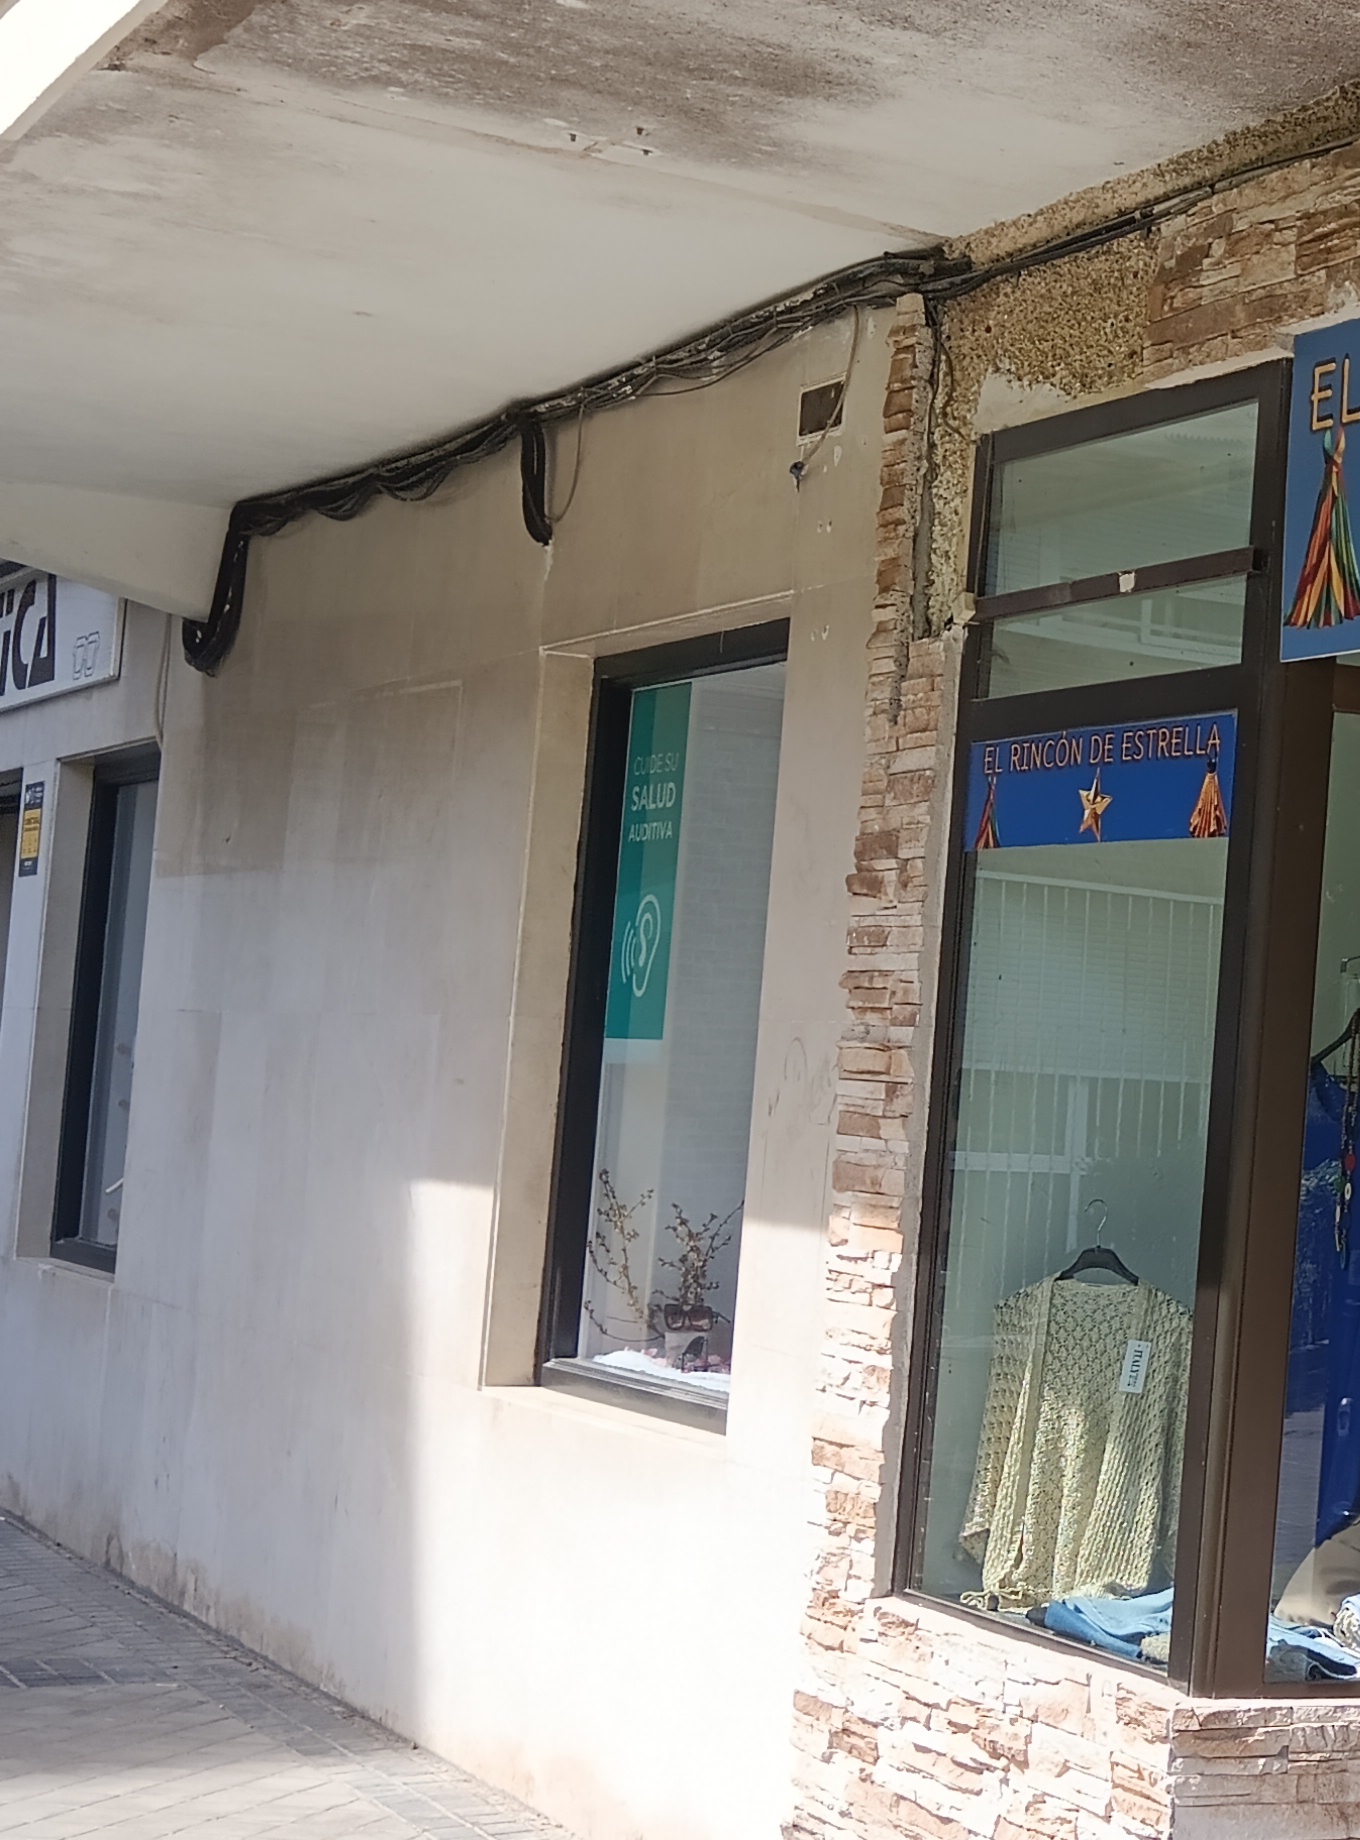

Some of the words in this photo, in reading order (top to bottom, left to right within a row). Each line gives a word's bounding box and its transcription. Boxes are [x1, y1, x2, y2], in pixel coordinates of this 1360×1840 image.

[983, 746, 1002, 774] EL
[1010, 730, 1084, 772] RINCÓN
[1089, 733, 1116, 764] DE
[1121, 723, 1221, 760] ESTRELLA
[665, 752, 679, 772] SU
[631, 782, 676, 811] SALUD
[628, 821, 673, 842] AUDITIVA
